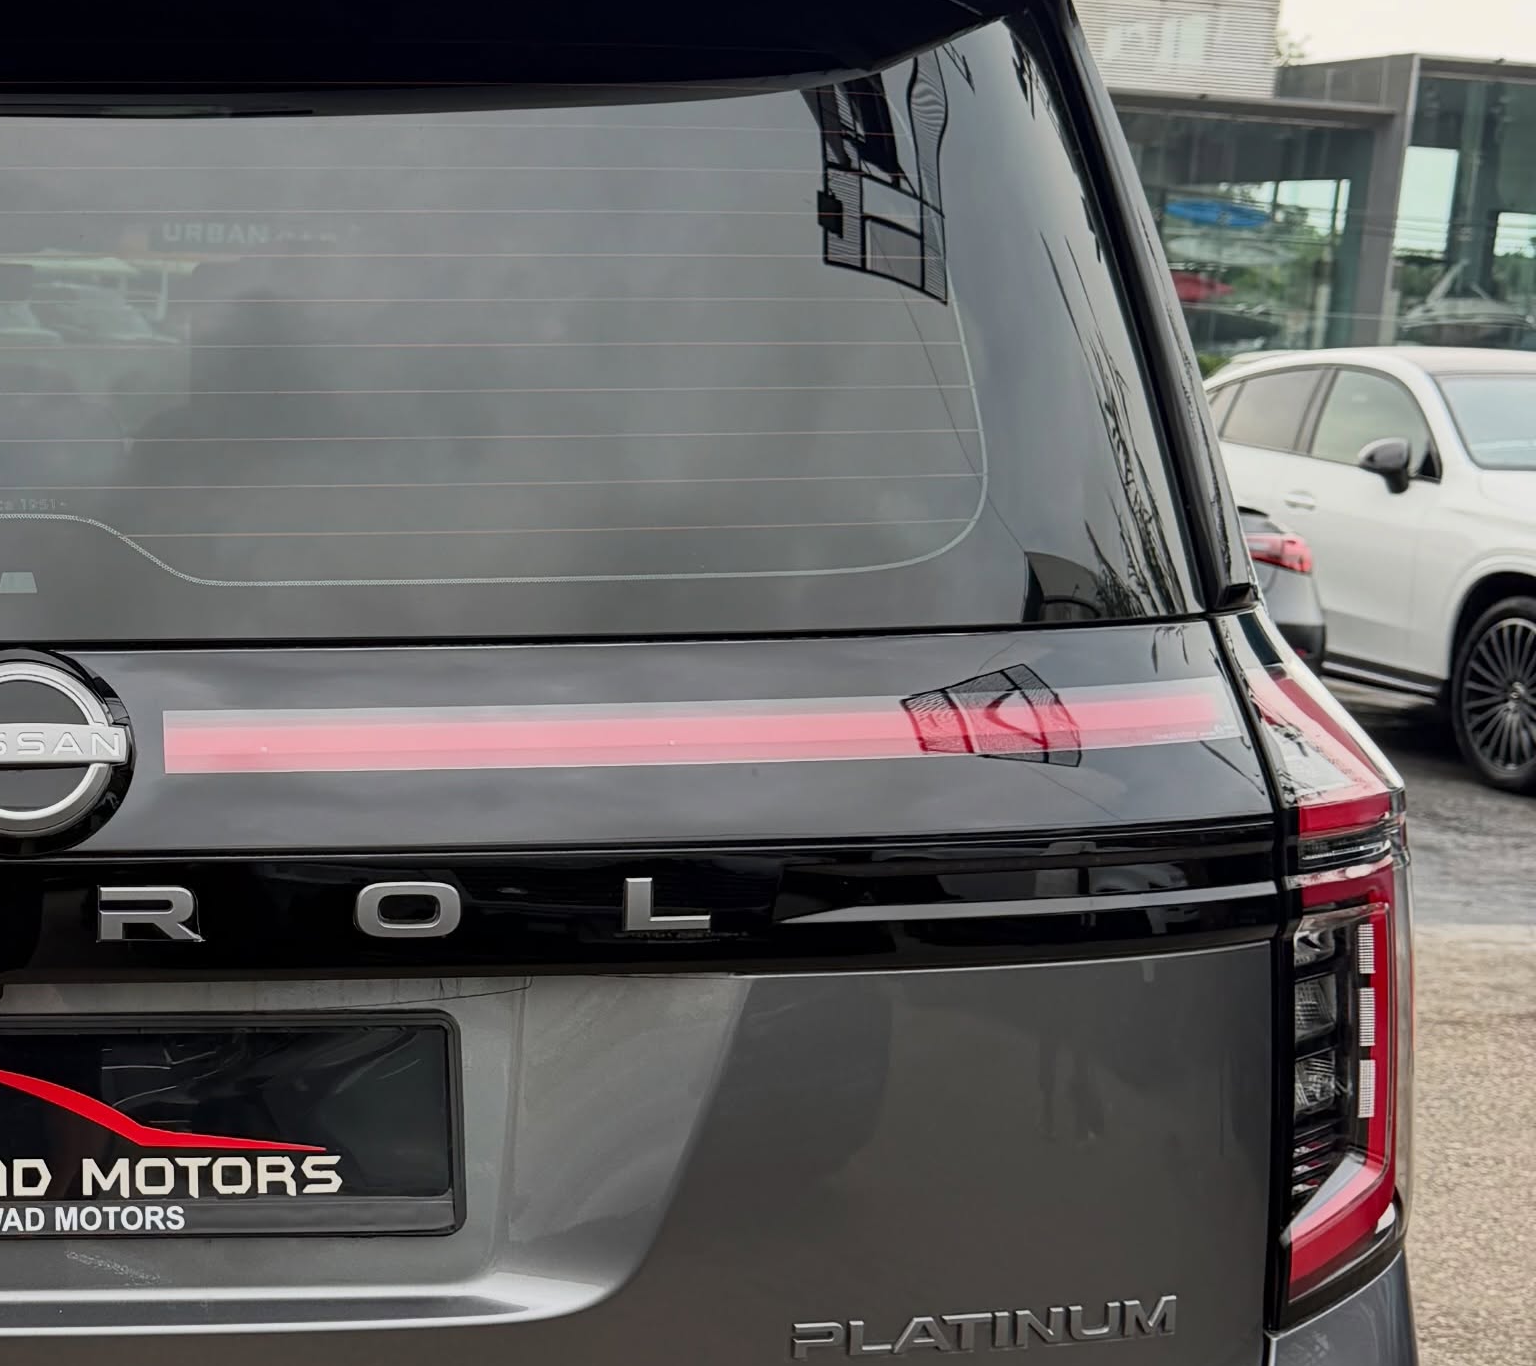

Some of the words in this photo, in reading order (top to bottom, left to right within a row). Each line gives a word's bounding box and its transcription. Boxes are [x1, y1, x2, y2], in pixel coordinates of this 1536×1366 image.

[82, 1154, 343, 1197] MOTORS
[54, 1206, 185, 1231] MOTORS
[791, 1294, 1177, 1359] PLATINUM
